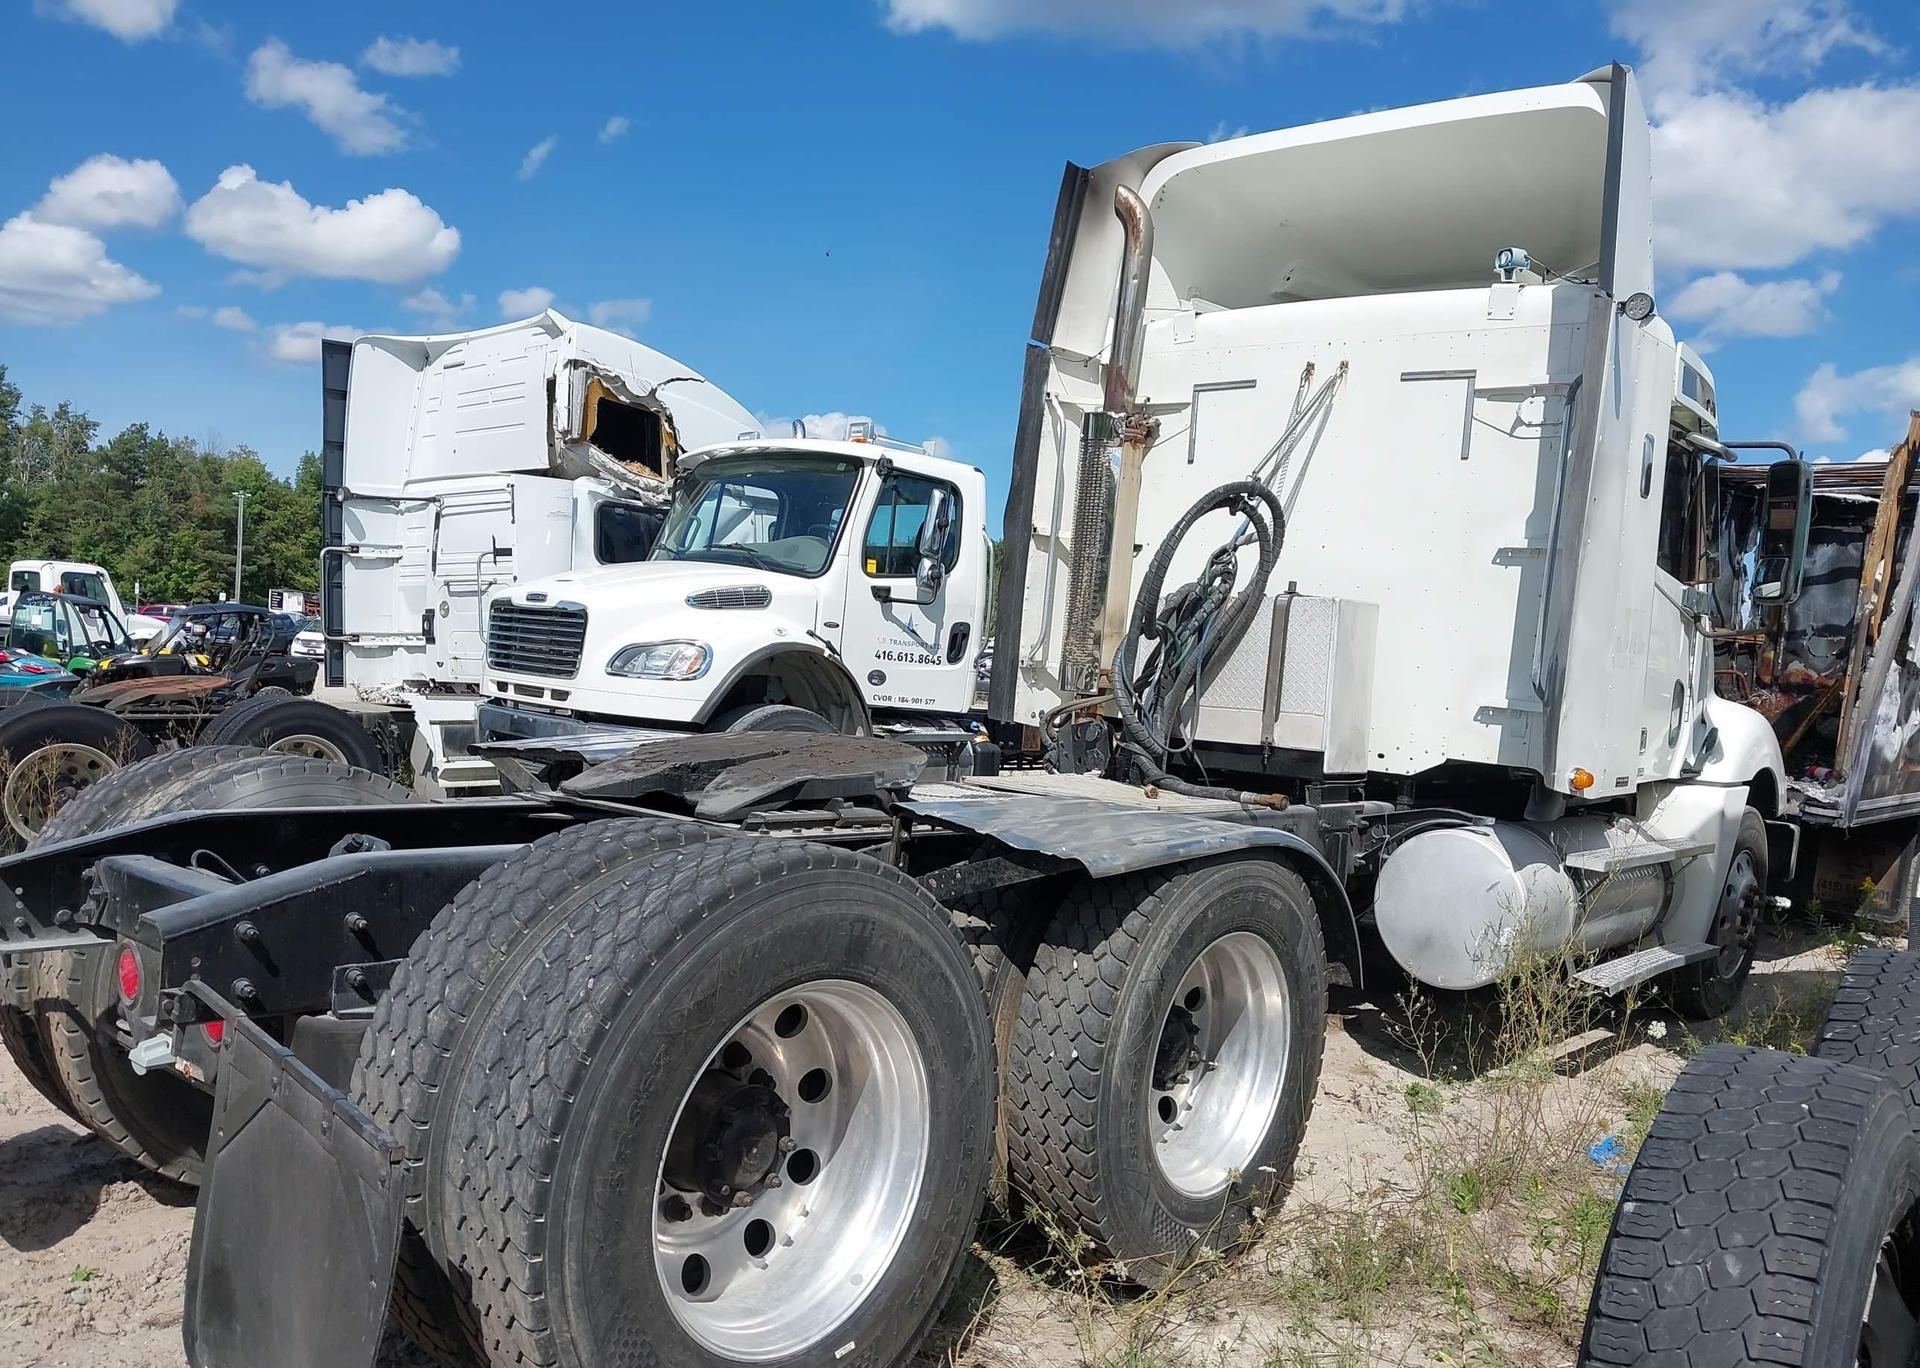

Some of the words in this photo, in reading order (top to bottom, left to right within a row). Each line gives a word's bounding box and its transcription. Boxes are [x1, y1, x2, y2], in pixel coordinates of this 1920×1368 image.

[889, 639, 929, 649] TRANSPORT
[875, 650, 942, 665] 416.613.8645
[873, 694, 892, 702] CVOR
